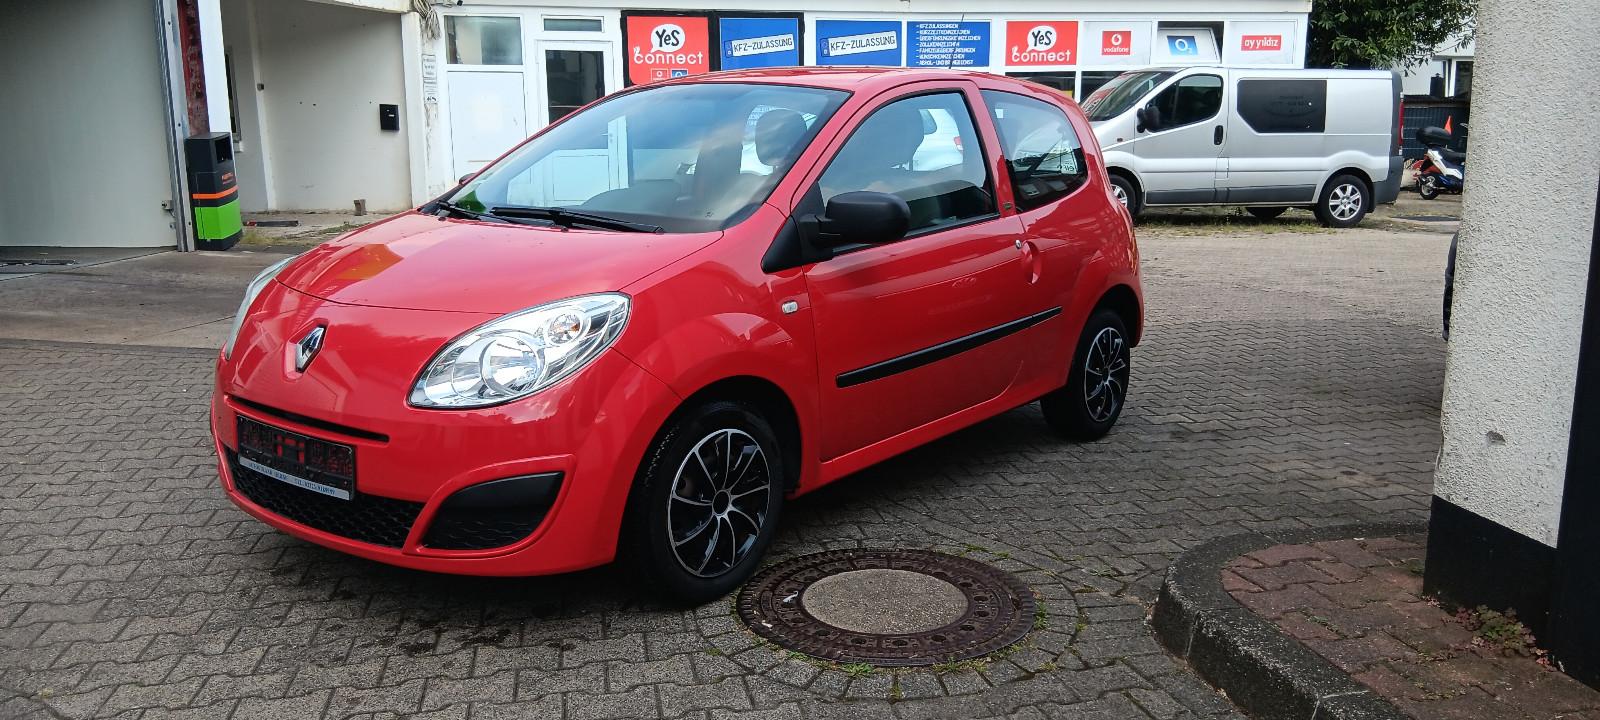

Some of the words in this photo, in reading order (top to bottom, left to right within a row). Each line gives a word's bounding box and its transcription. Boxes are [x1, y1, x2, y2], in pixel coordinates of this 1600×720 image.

[733, 37, 793, 53] KFZ-ZULASSUNG
[830, 35, 896, 52] KFZ-ZULASSUNG
[634, 51, 704, 65] connect
[1012, 49, 1071, 63] connect
